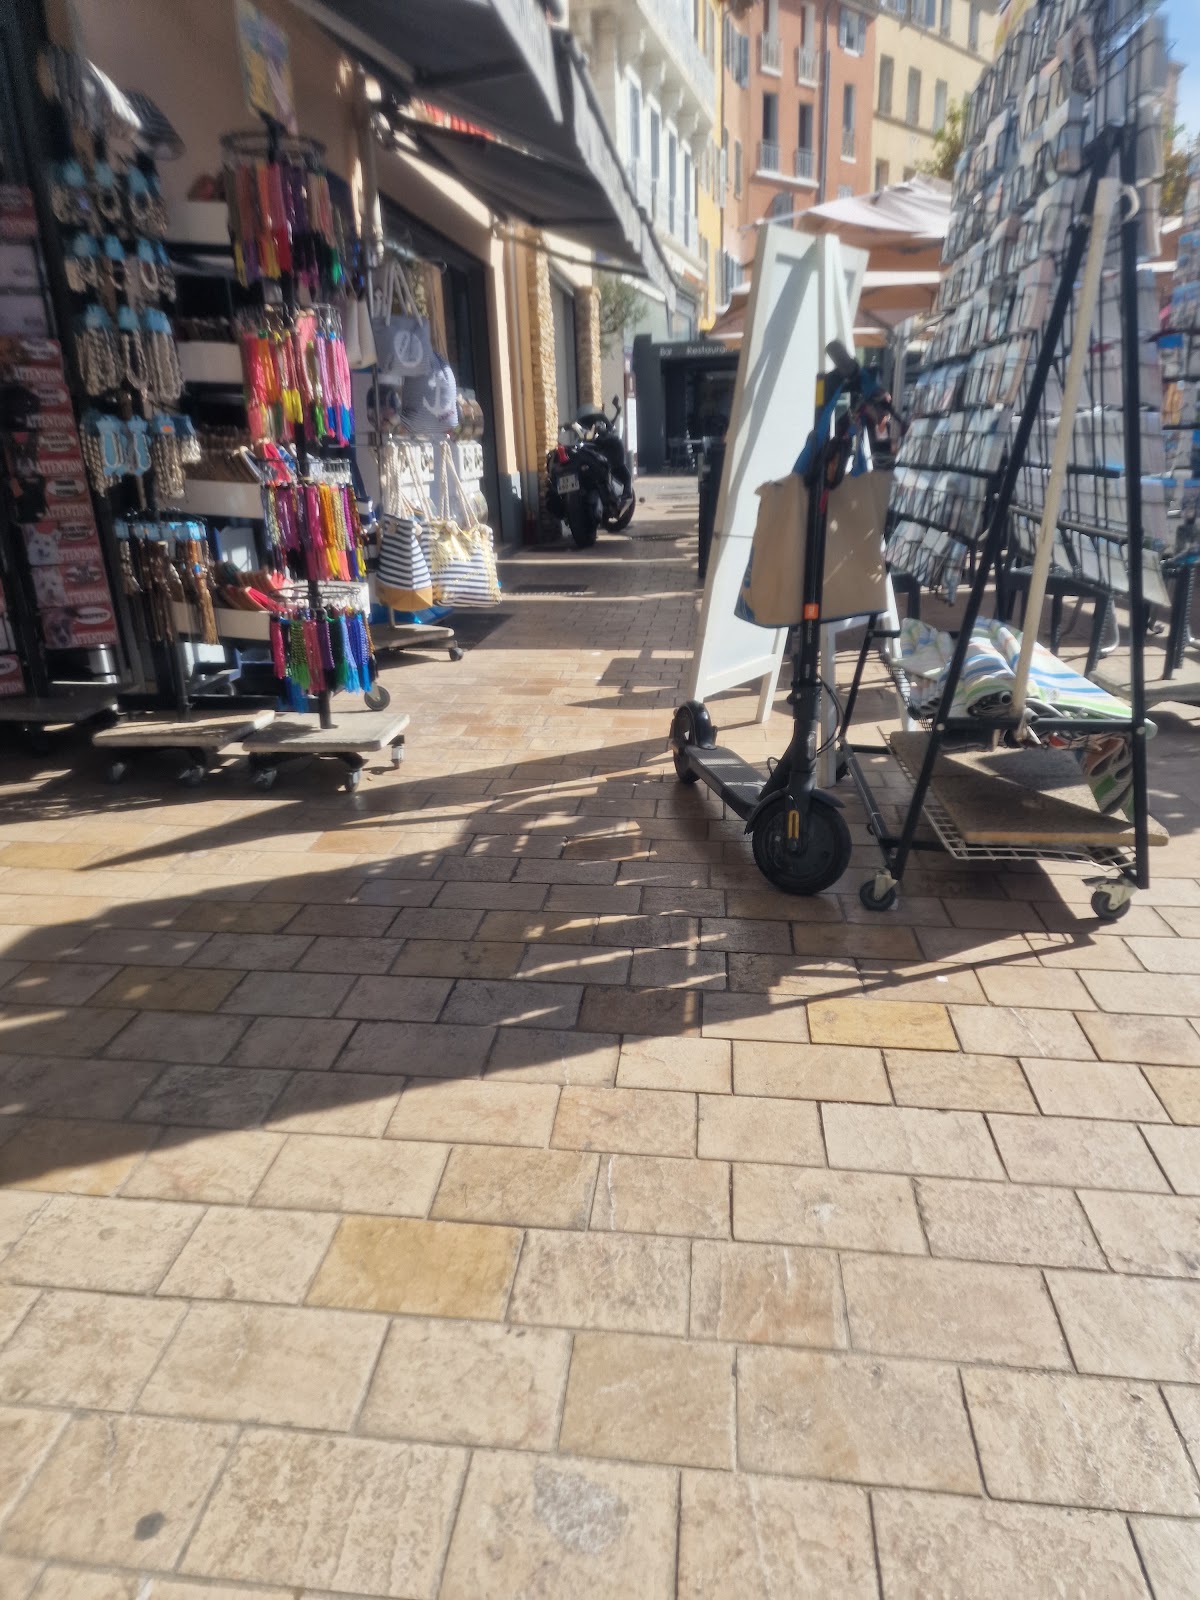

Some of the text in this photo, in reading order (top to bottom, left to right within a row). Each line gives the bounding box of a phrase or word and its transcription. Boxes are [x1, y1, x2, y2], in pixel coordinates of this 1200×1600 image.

[36, 460, 83, 475] ATTENTION
[45, 503, 92, 519] ATTENTION
[72, 631, 117, 645] ATTENTION
